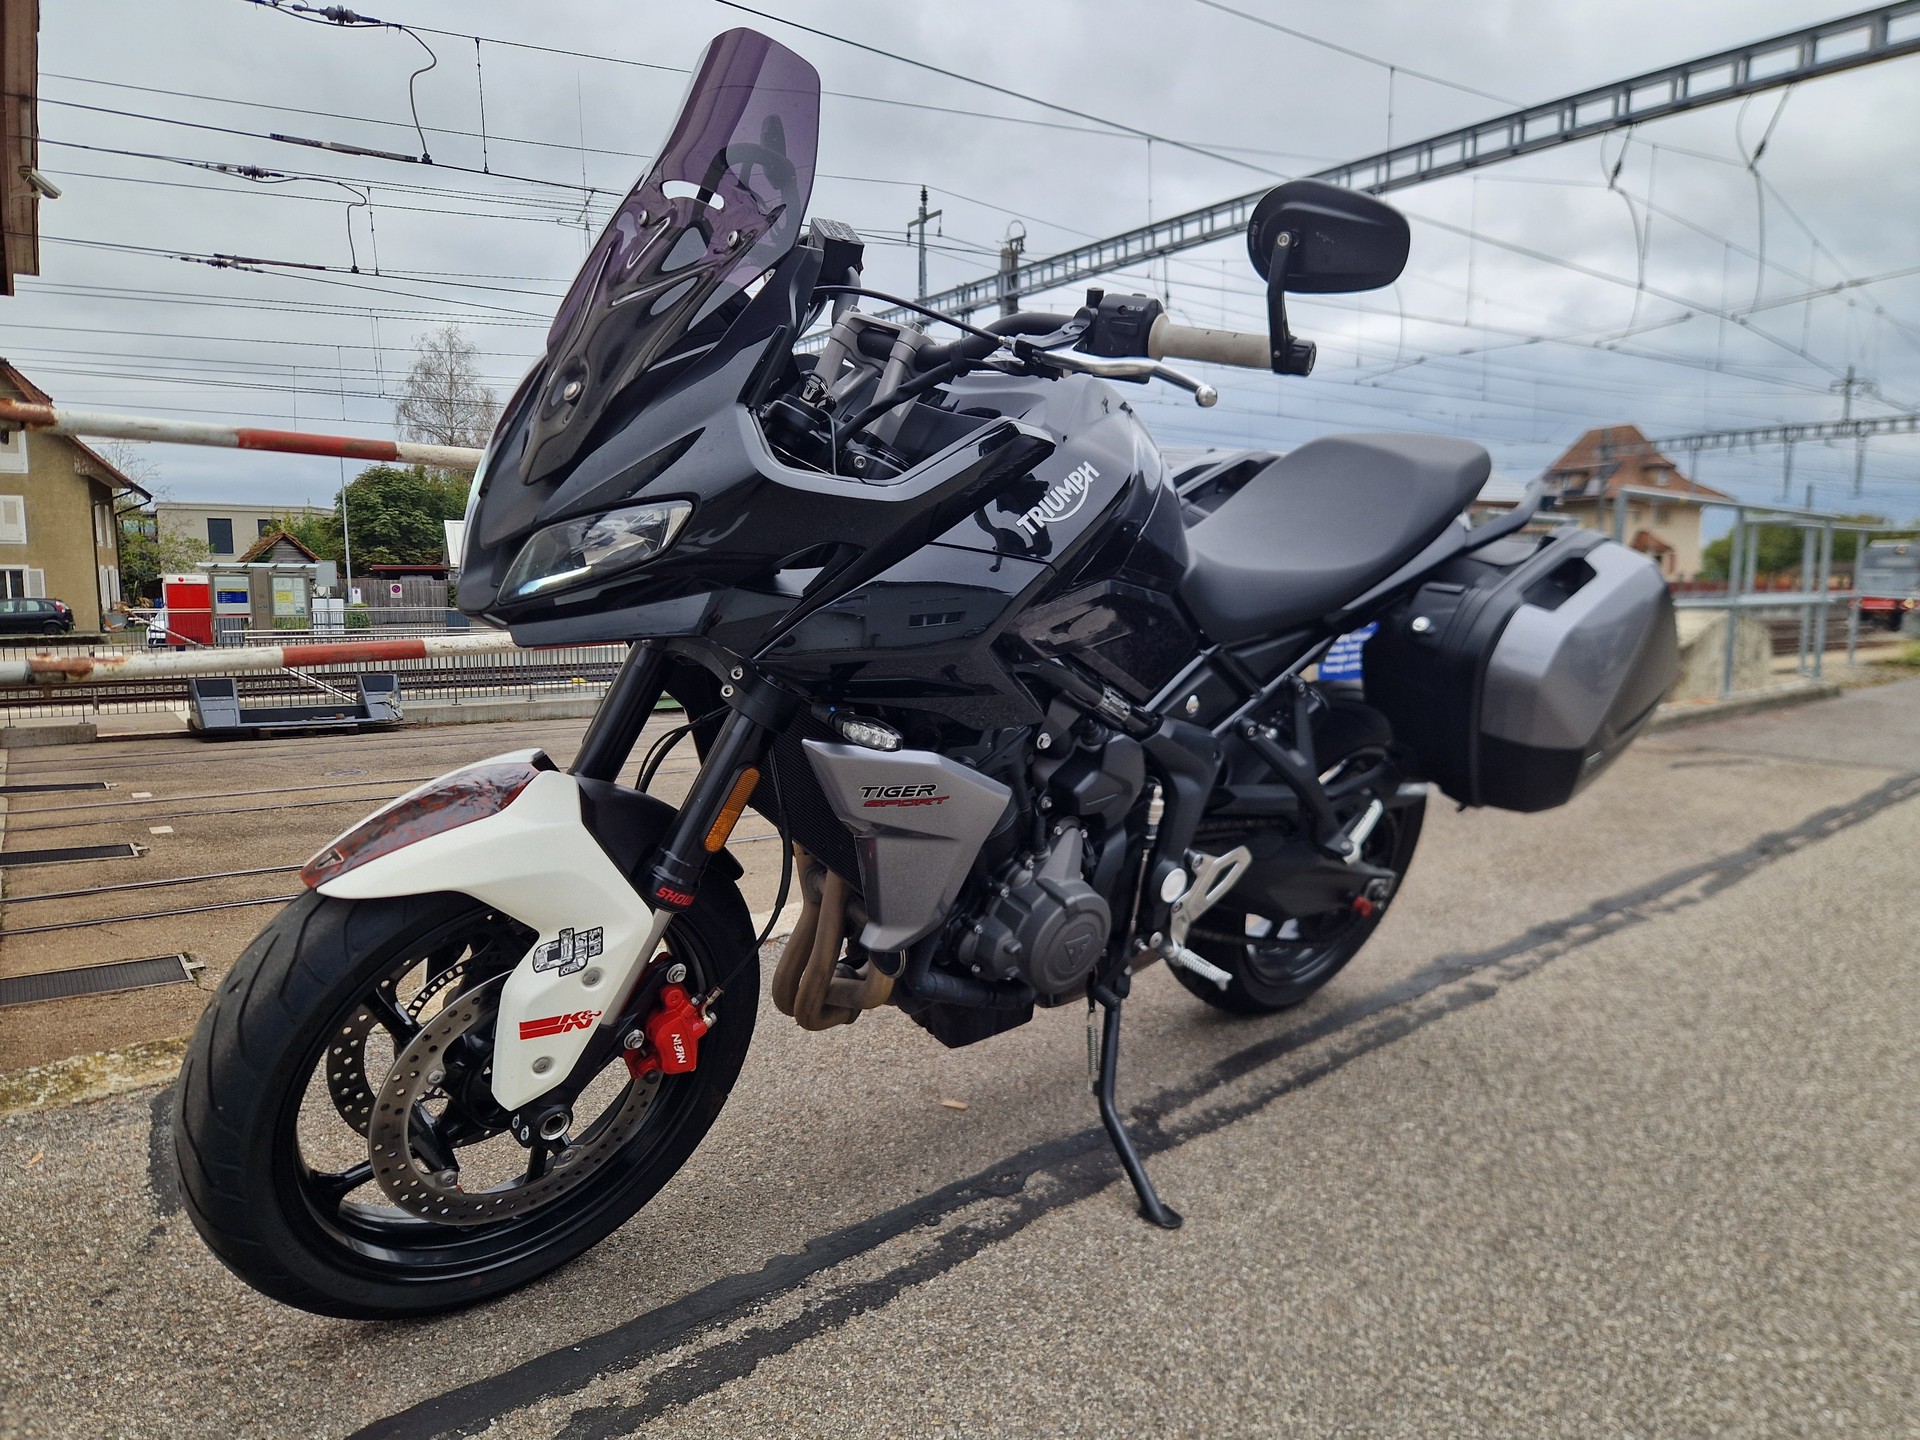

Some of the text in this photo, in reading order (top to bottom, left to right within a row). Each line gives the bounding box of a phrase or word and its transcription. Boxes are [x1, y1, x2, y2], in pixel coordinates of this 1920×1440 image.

[1015, 460, 1100, 535] TRIUMPH
[860, 783, 937, 799] TIGER
[863, 796, 950, 808] SPORT
[655, 886, 695, 906] SHOW
